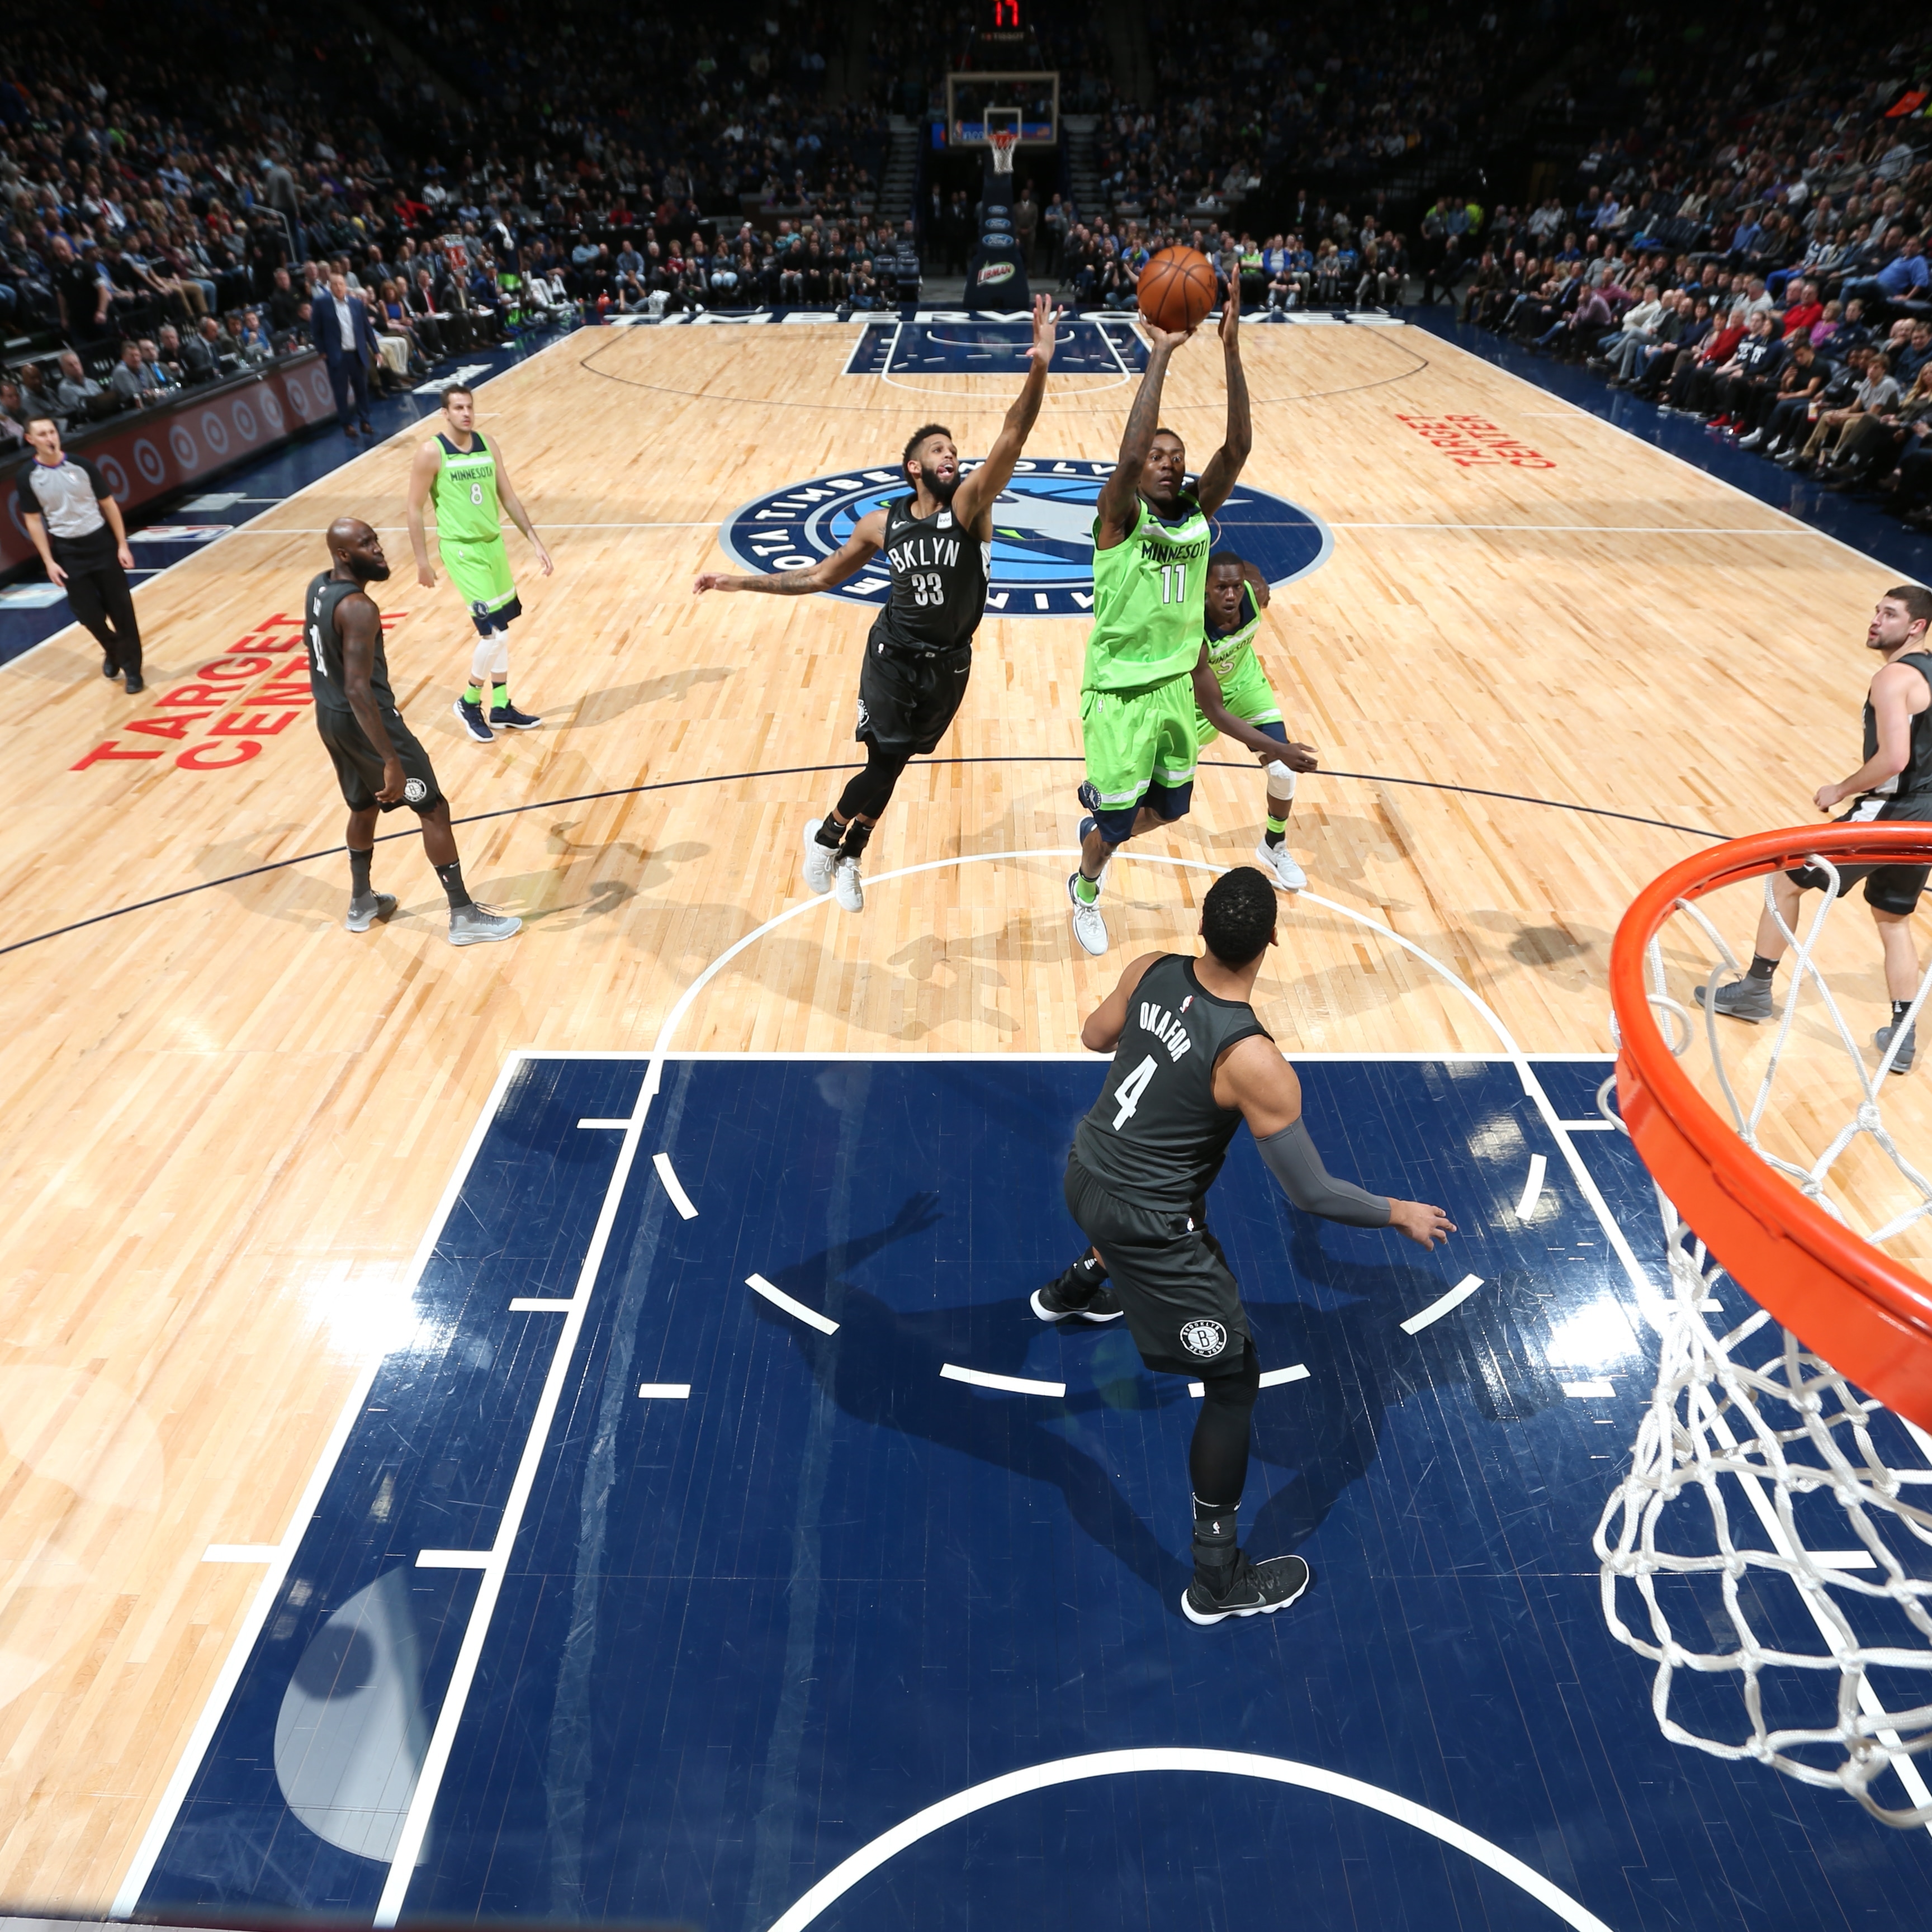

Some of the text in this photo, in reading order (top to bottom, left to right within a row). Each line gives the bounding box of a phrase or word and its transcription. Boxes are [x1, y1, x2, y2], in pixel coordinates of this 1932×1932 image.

[604, 311, 1405, 325] TIMBERWOVES
[1395, 414, 1501, 466] TARGET
[1444, 415, 1557, 468] CENTER
[450, 466, 493, 481] MINNESOTA
[470, 482, 483, 505] 8
[888, 537, 960, 574] BKLYN
[911, 572, 944, 605] 33
[1161, 564, 1186, 604] 11
[1216, 655, 1236, 675] 5
[69, 613, 307, 771] TARGET
[1139, 1001, 1192, 1063] OKAFOR
[1112, 1054, 1158, 1131] 4
[1183, 1322, 1220, 1336] BROOKLYN
[1197, 1330, 1210, 1347] B
[1189, 1341, 1223, 1355] NEW YORK
